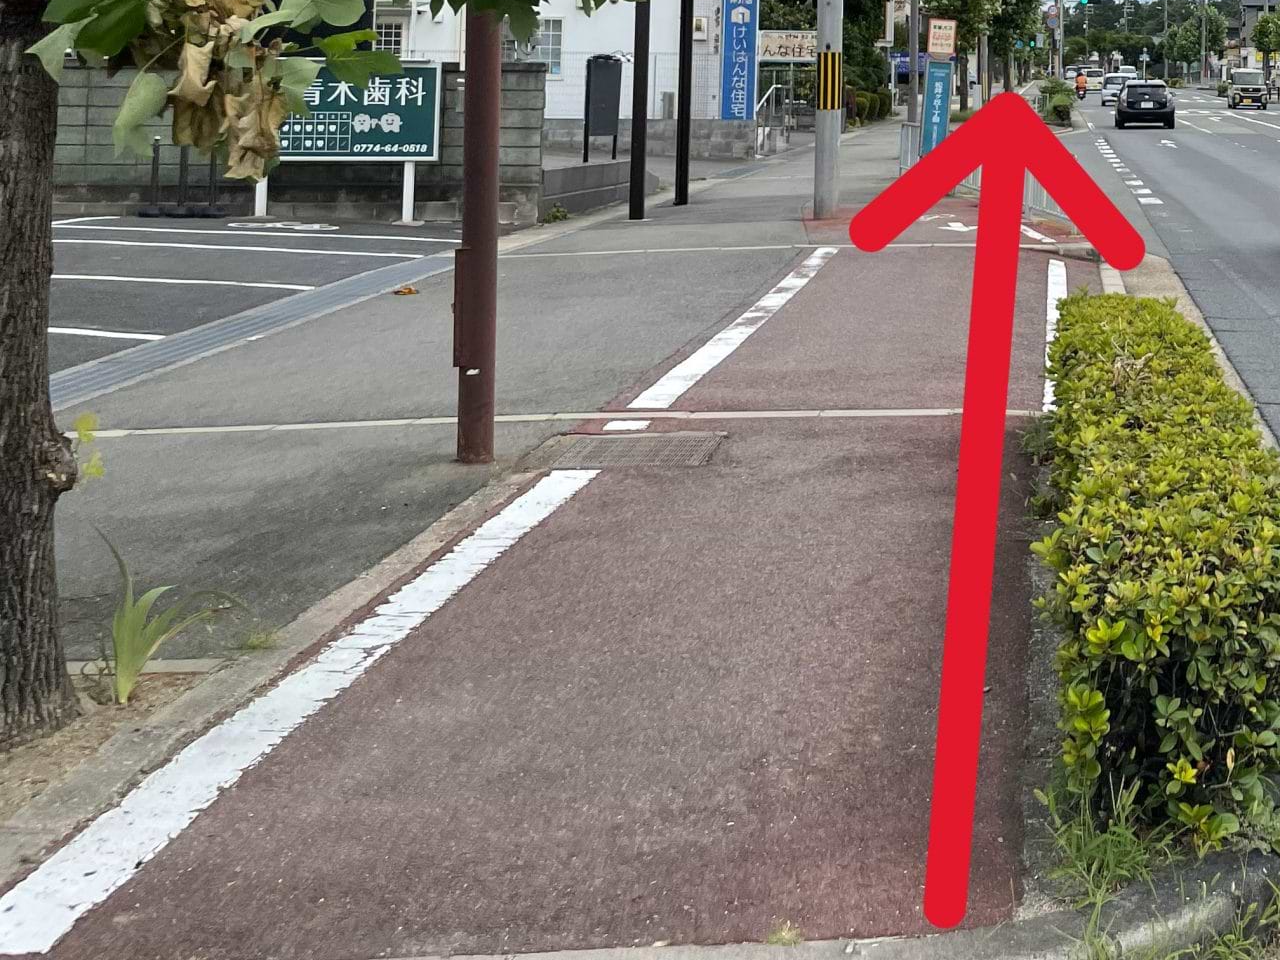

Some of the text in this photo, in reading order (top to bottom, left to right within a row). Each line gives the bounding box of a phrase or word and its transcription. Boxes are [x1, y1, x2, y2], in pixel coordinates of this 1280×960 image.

[731, 25, 748, 117] けいはんな住宅
[353, 144, 428, 153] 0774-64-0518
